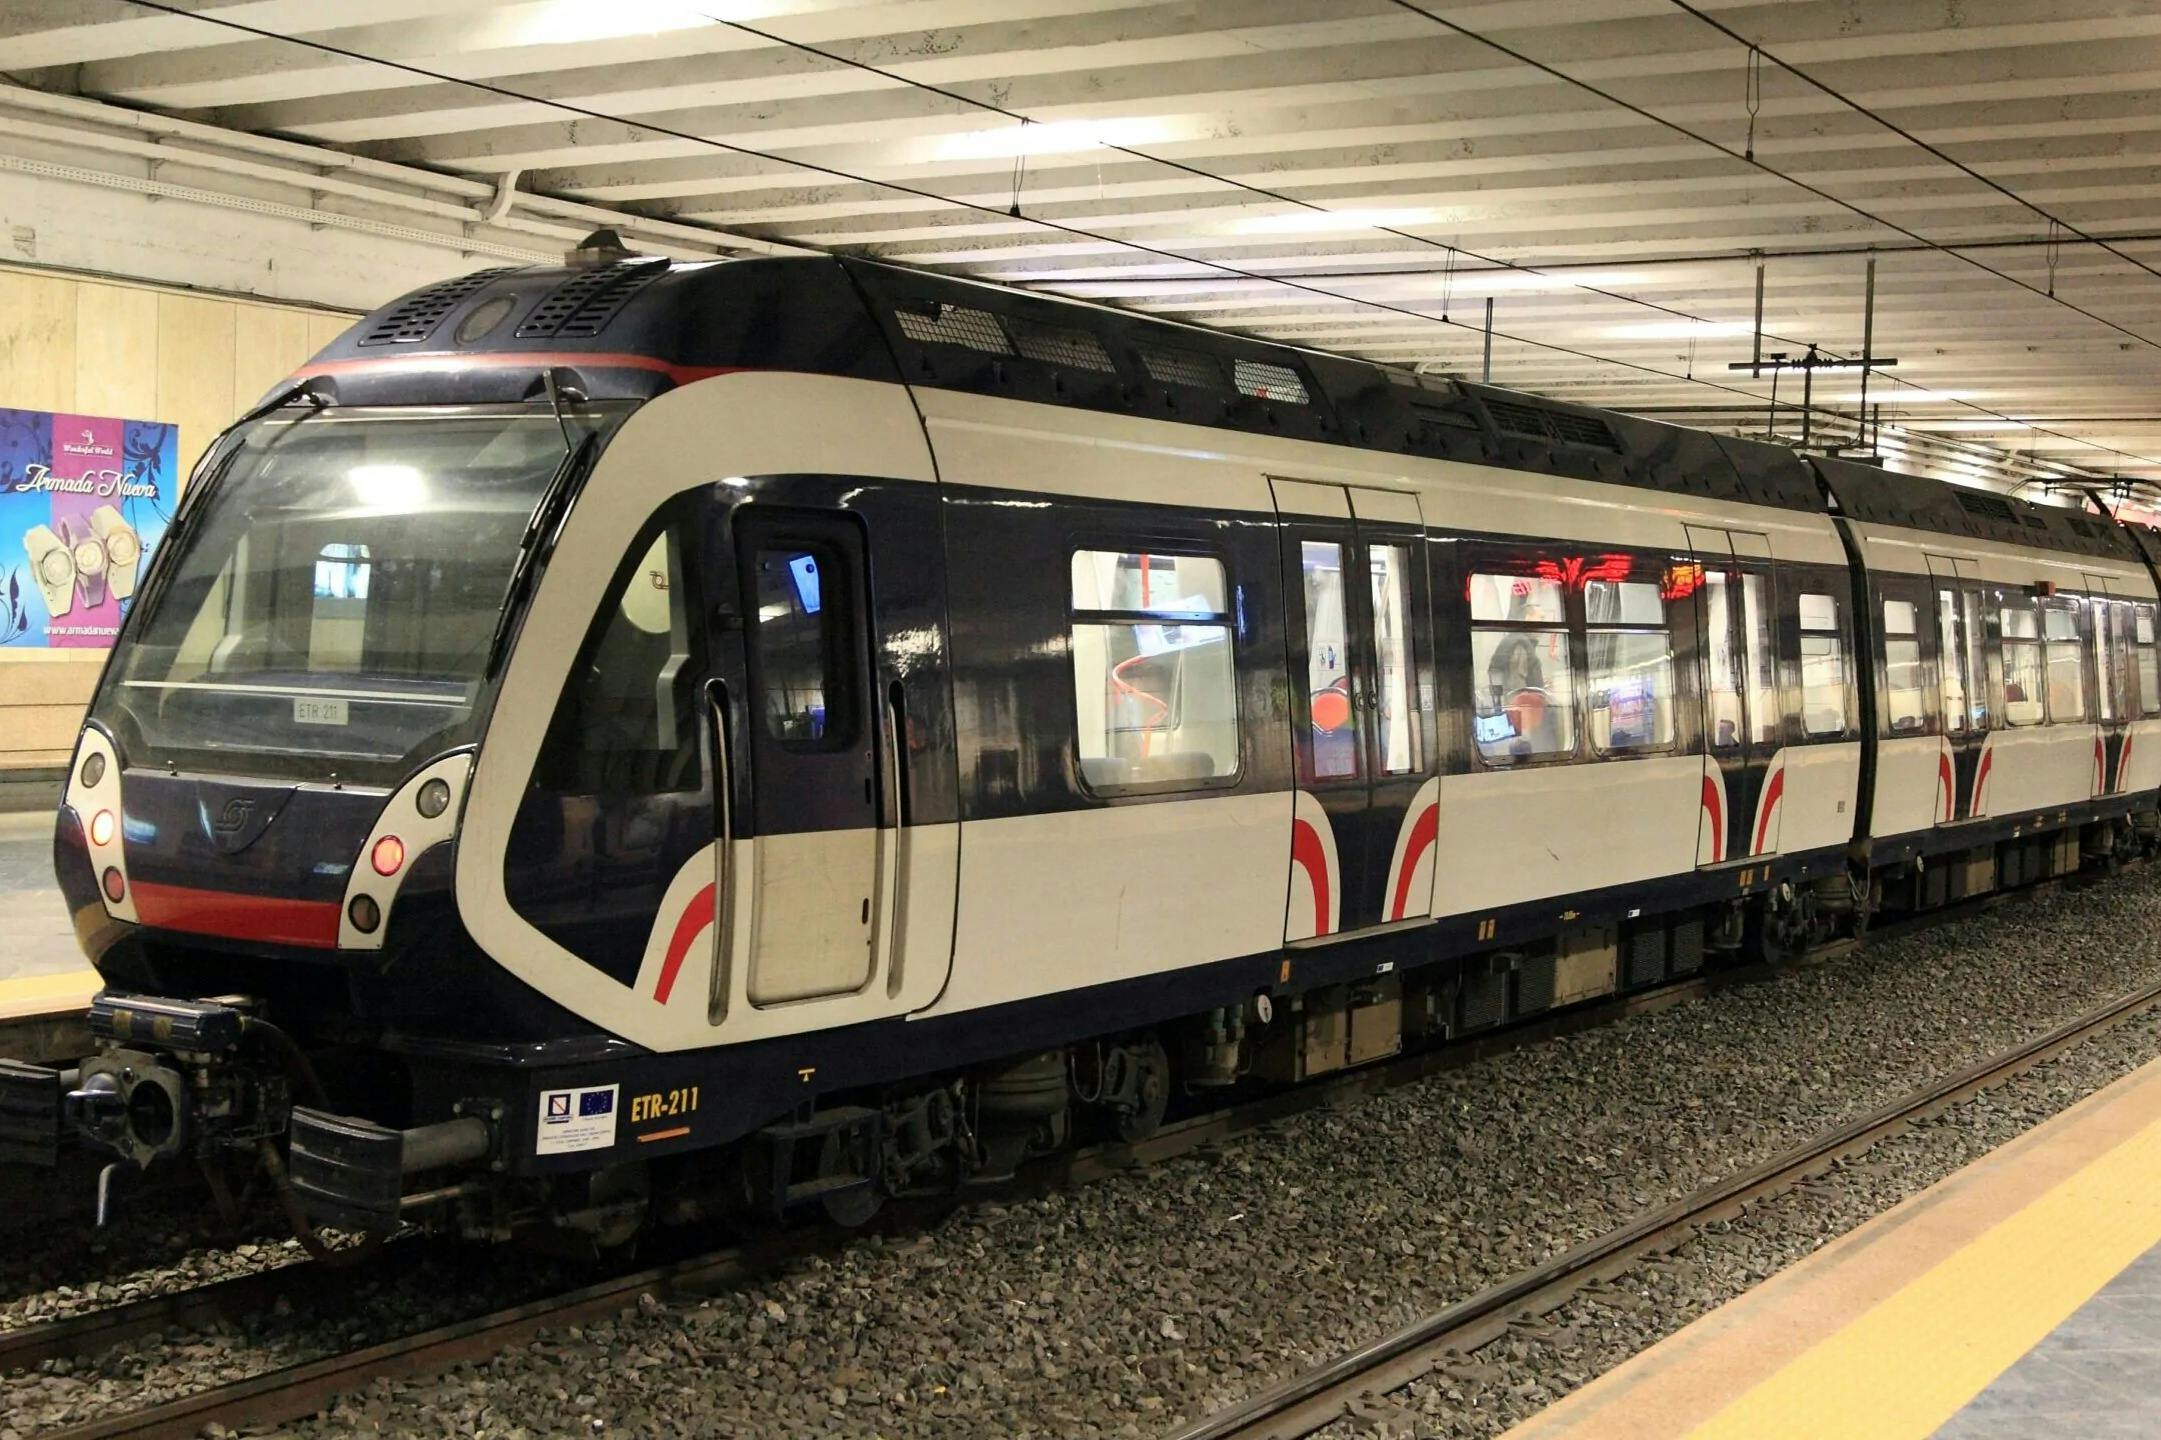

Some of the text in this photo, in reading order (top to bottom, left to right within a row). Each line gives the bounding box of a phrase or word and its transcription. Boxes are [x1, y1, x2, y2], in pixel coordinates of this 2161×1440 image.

[16, 463, 156, 497] Armada Nueva
[631, 1086, 699, 1122] ETR-211
